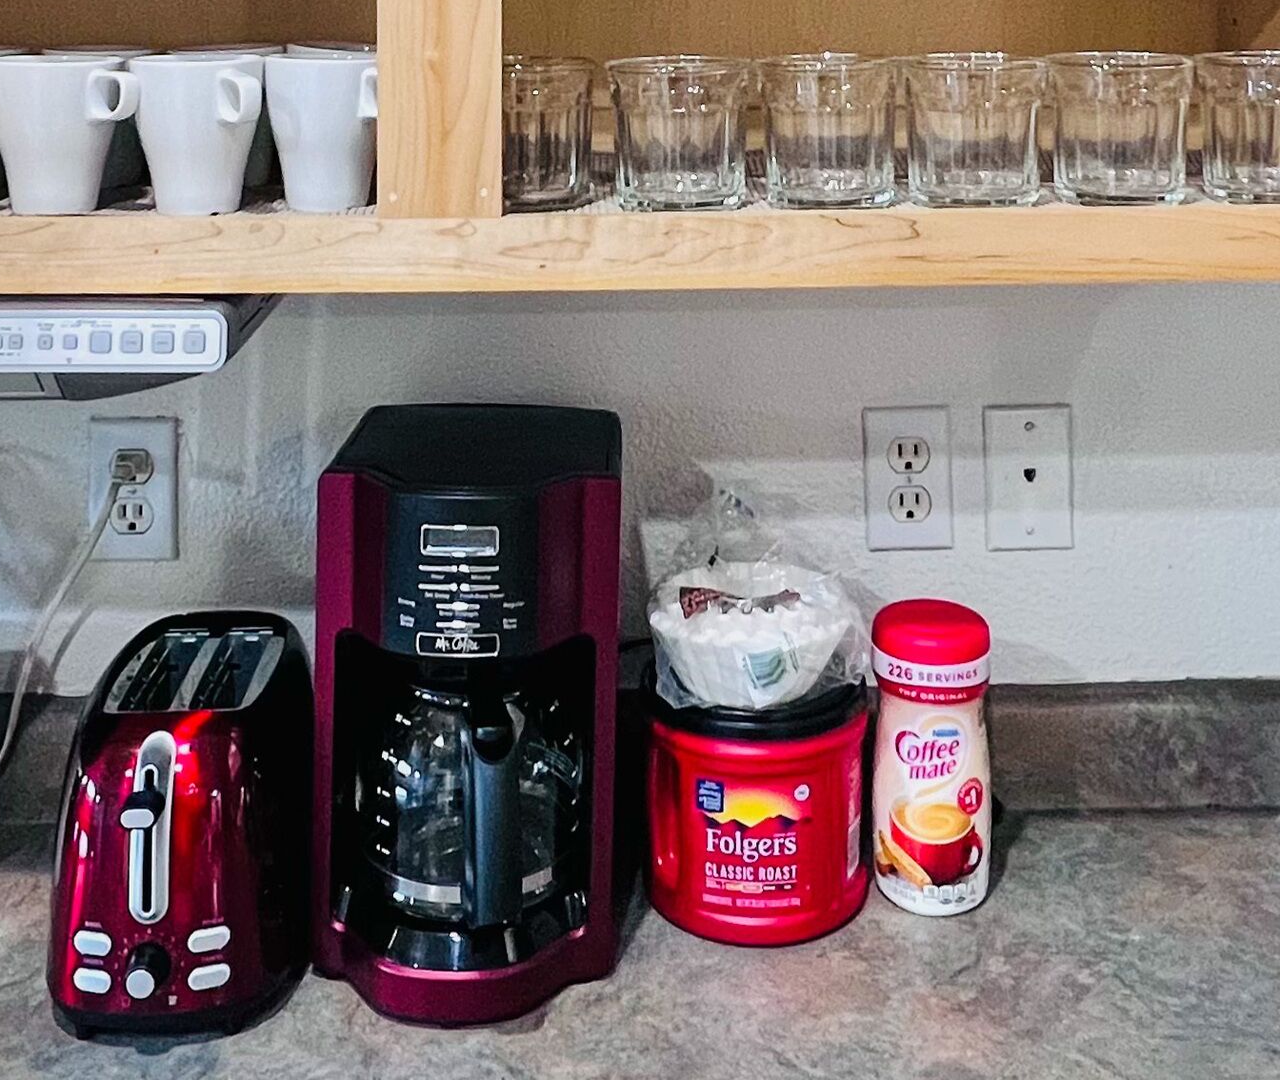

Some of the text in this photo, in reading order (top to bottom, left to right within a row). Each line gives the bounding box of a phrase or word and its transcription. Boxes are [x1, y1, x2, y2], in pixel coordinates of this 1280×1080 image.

[887, 663, 978, 683] 226 SERVINGS
[909, 758, 957, 780] mate
[705, 827, 797, 863] Folgers
[705, 861, 798, 881] CLASSIC ROAST
